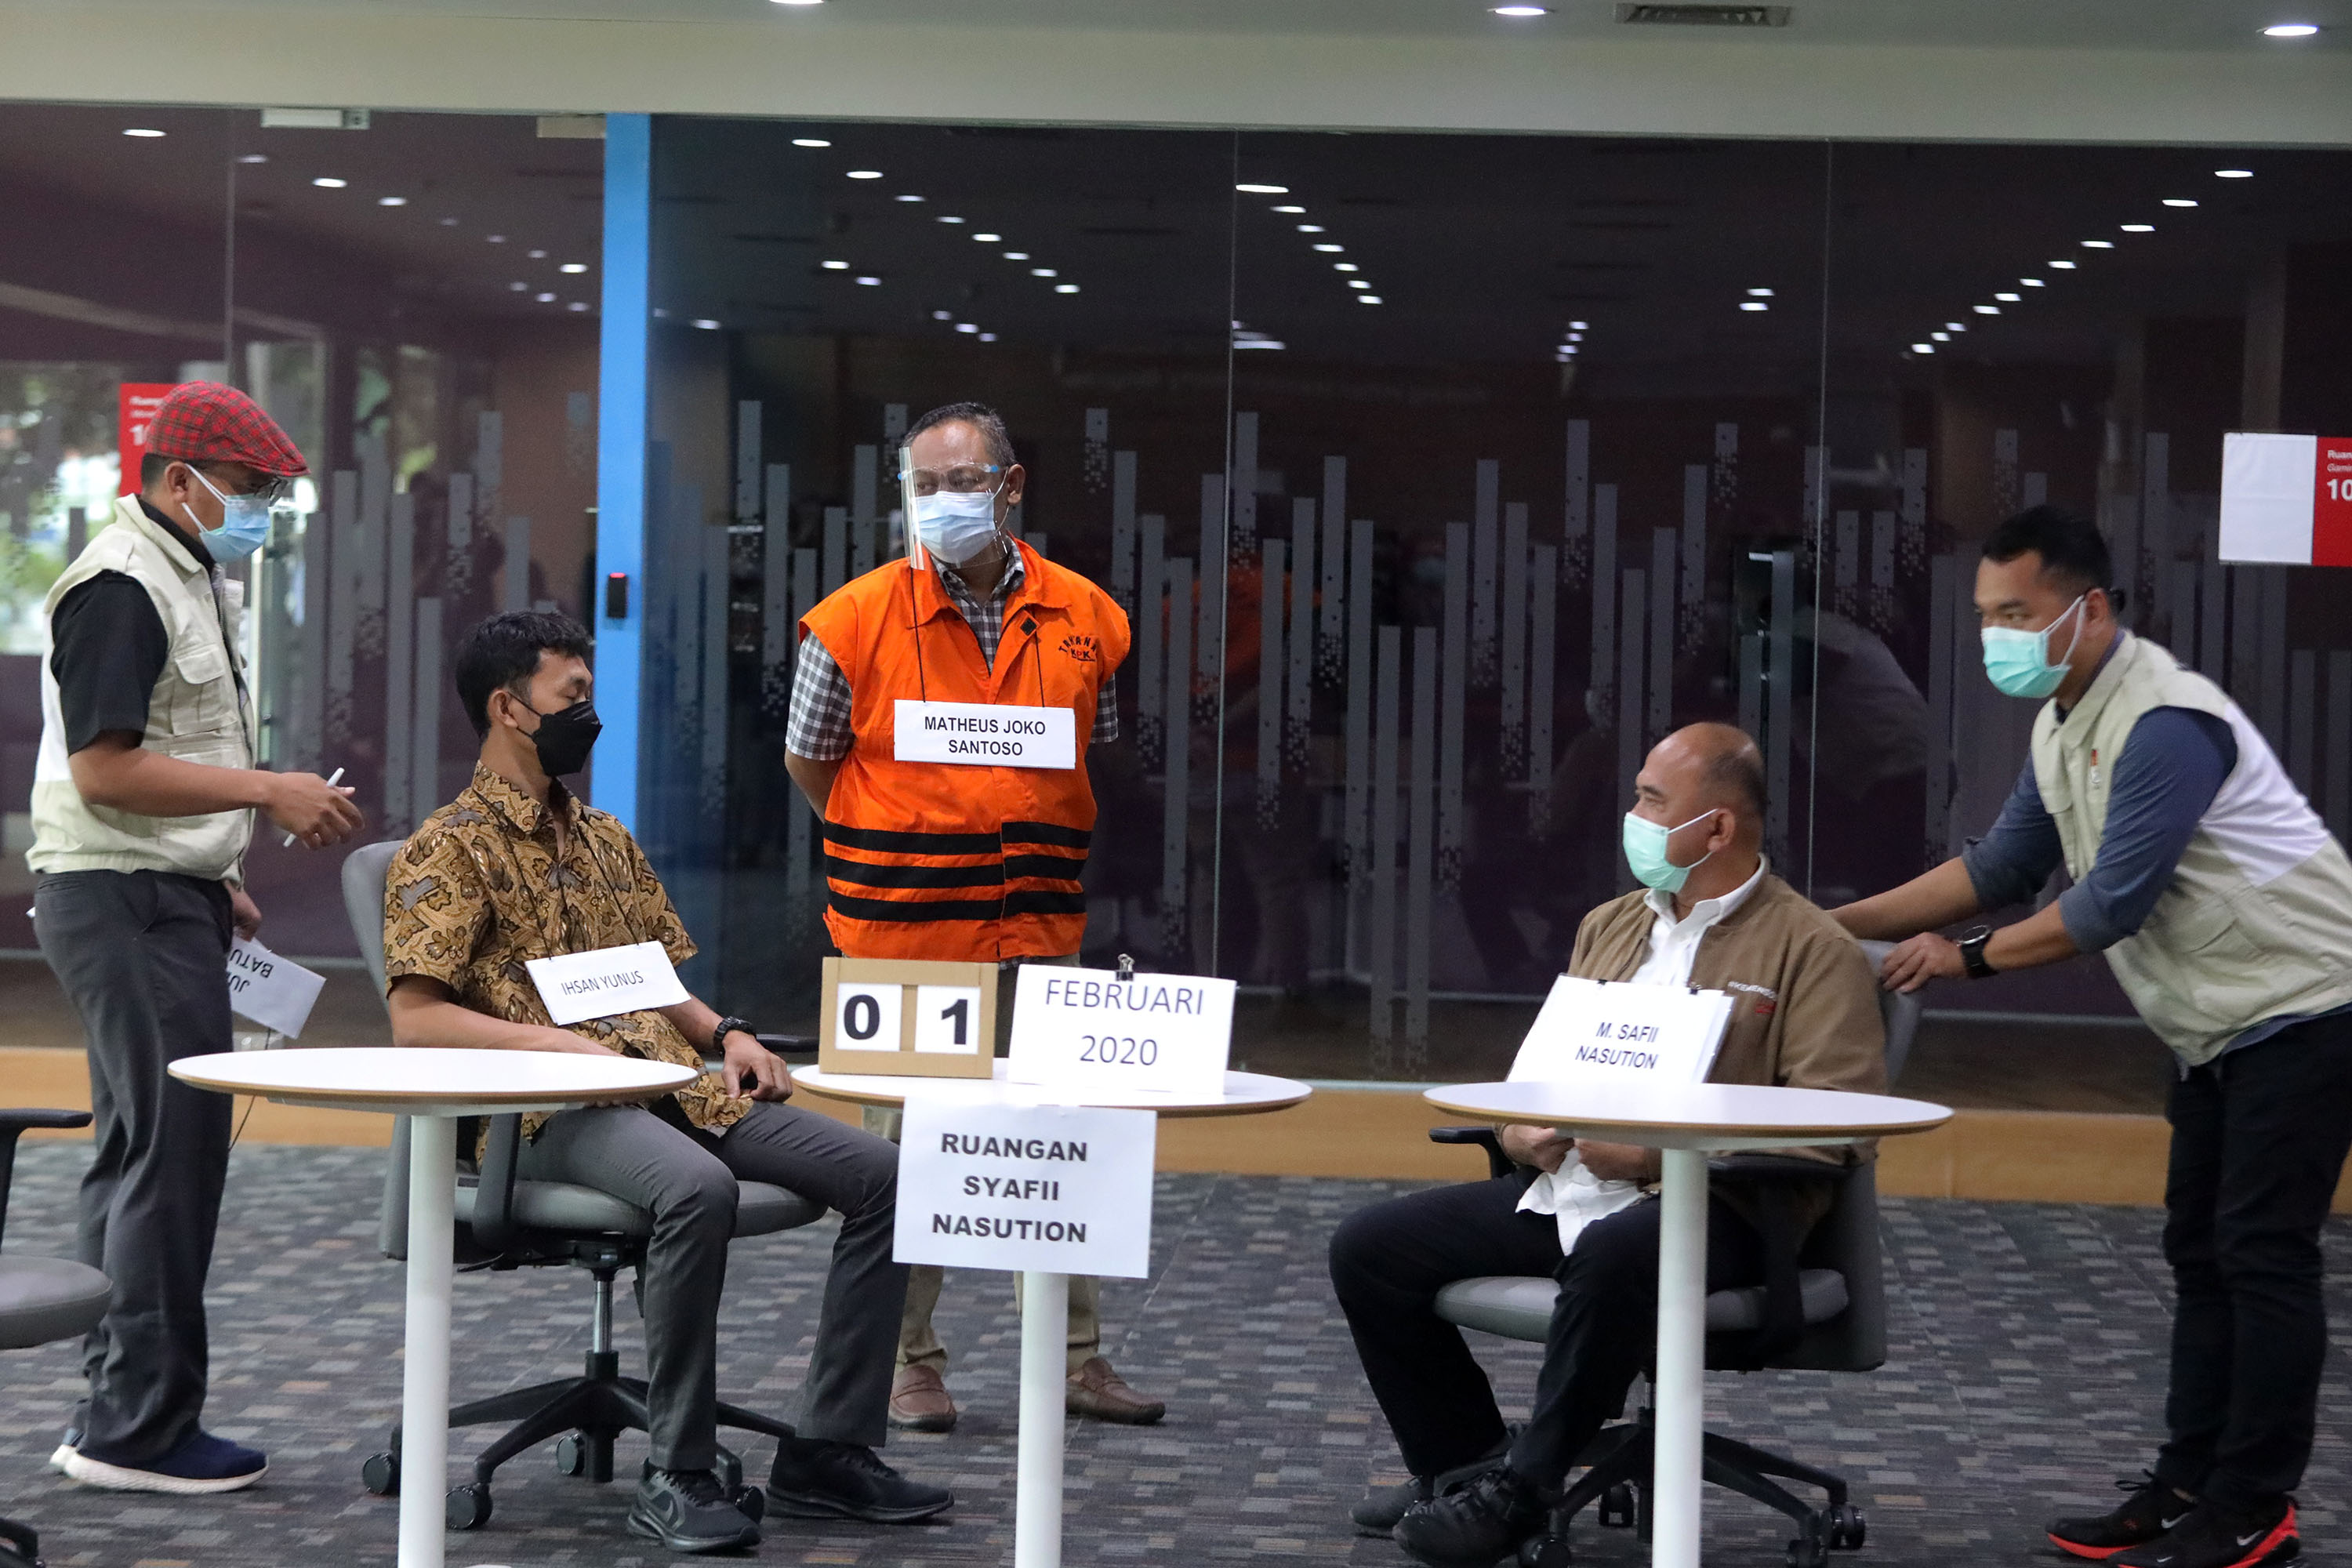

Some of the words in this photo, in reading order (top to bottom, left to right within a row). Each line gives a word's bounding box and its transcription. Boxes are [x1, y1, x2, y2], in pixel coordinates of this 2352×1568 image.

[129, 424, 147, 445] 1
[2327, 478, 2352, 501] 10
[924, 716, 999, 733] MATHEUS
[1003, 720, 1046, 735] JOKO
[949, 739, 1023, 756] SANTOSO
[561, 977, 601, 996] IHSAN
[600, 970, 644, 989] YUNUS
[1045, 978, 1204, 1015] FEBRUARI
[844, 994, 880, 1040] 0
[941, 999, 968, 1045] 1
[1595, 1022, 1613, 1038] M.
[1617, 1023, 1659, 1044] SAFII
[1080, 1035, 1158, 1066] 2020
[1574, 1045, 1659, 1069] NASUTION
[941, 1133, 1087, 1162] RUANGAN
[964, 1175, 1059, 1201] SYAFII
[932, 1214, 1087, 1243] NASUTION
